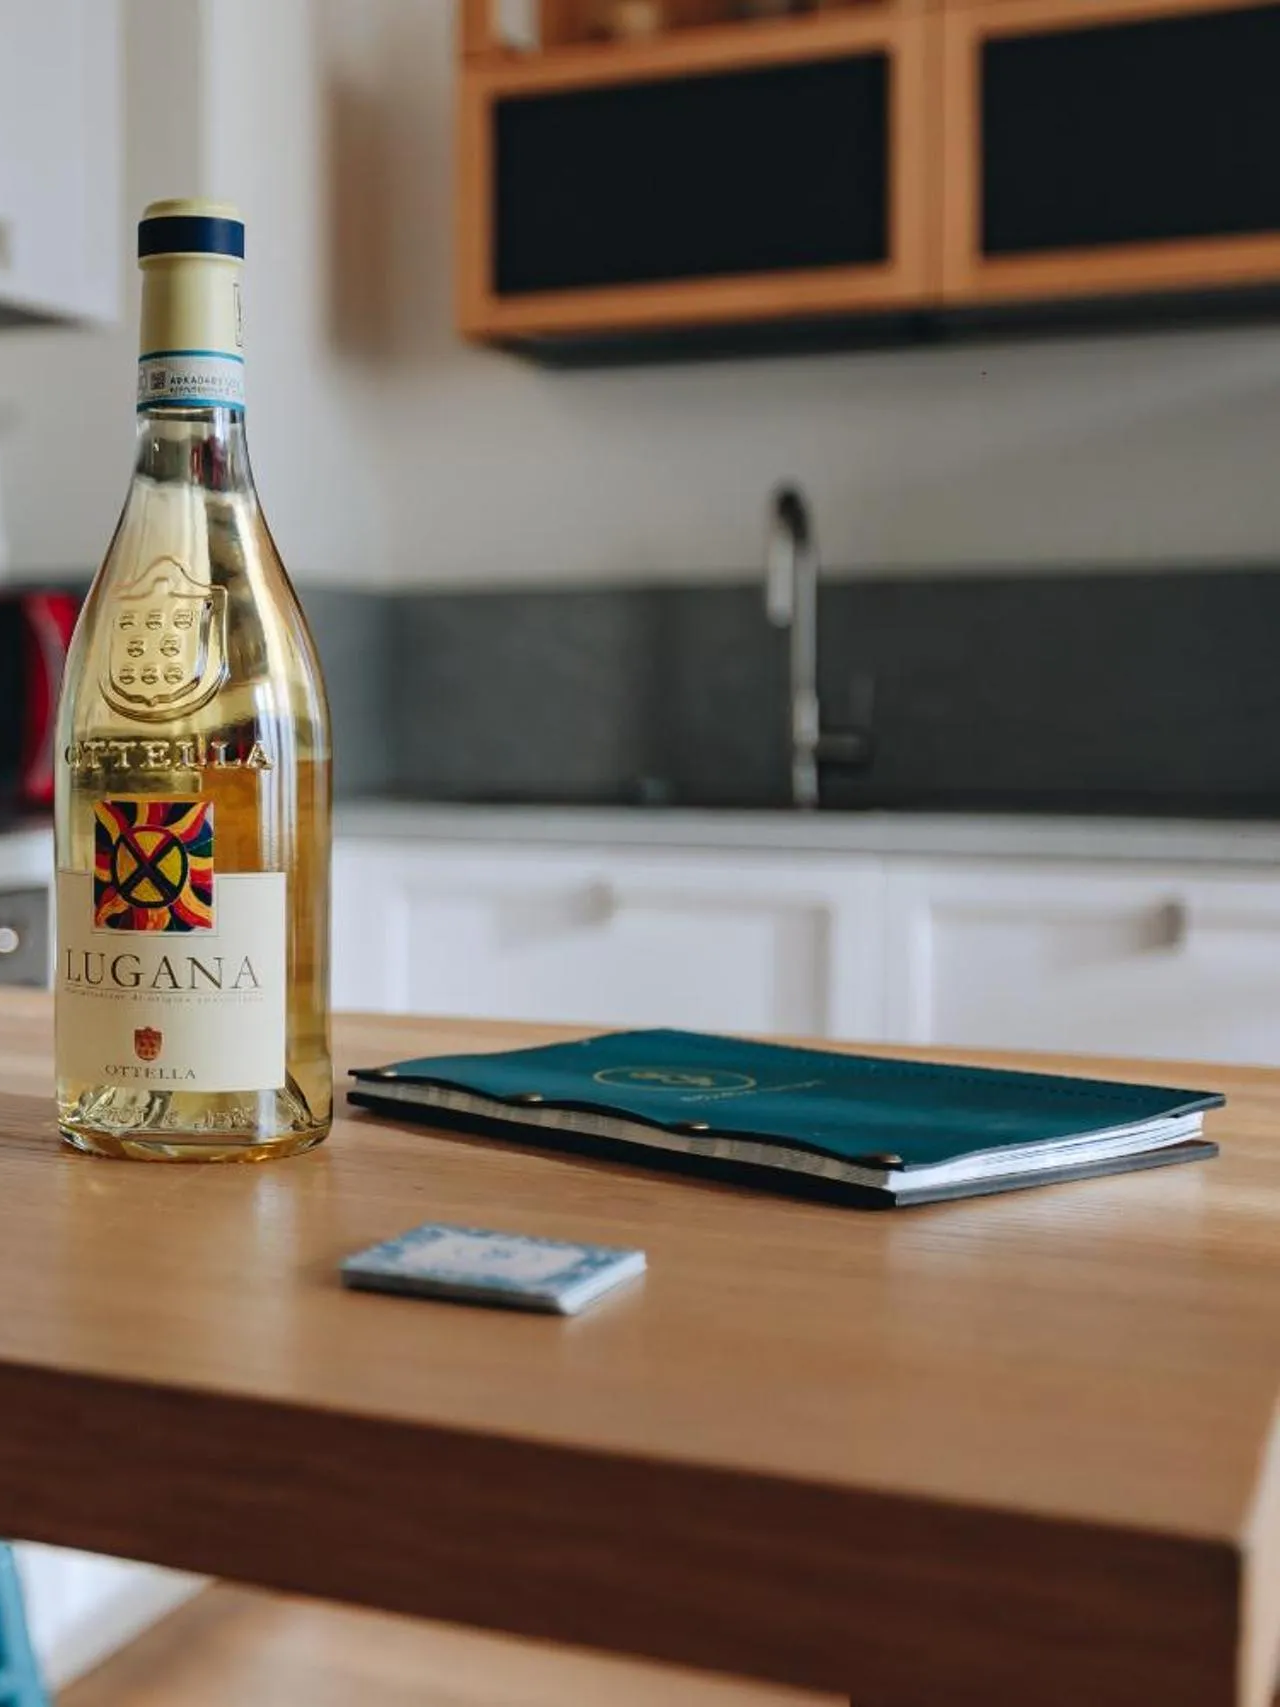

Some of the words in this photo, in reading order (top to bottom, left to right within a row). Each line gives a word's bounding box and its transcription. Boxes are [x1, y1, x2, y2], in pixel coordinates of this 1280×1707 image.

[64, 739, 275, 771] OTTELLA
[66, 948, 263, 990] LUGANA
[104, 1063, 197, 1081] OTTELLA
